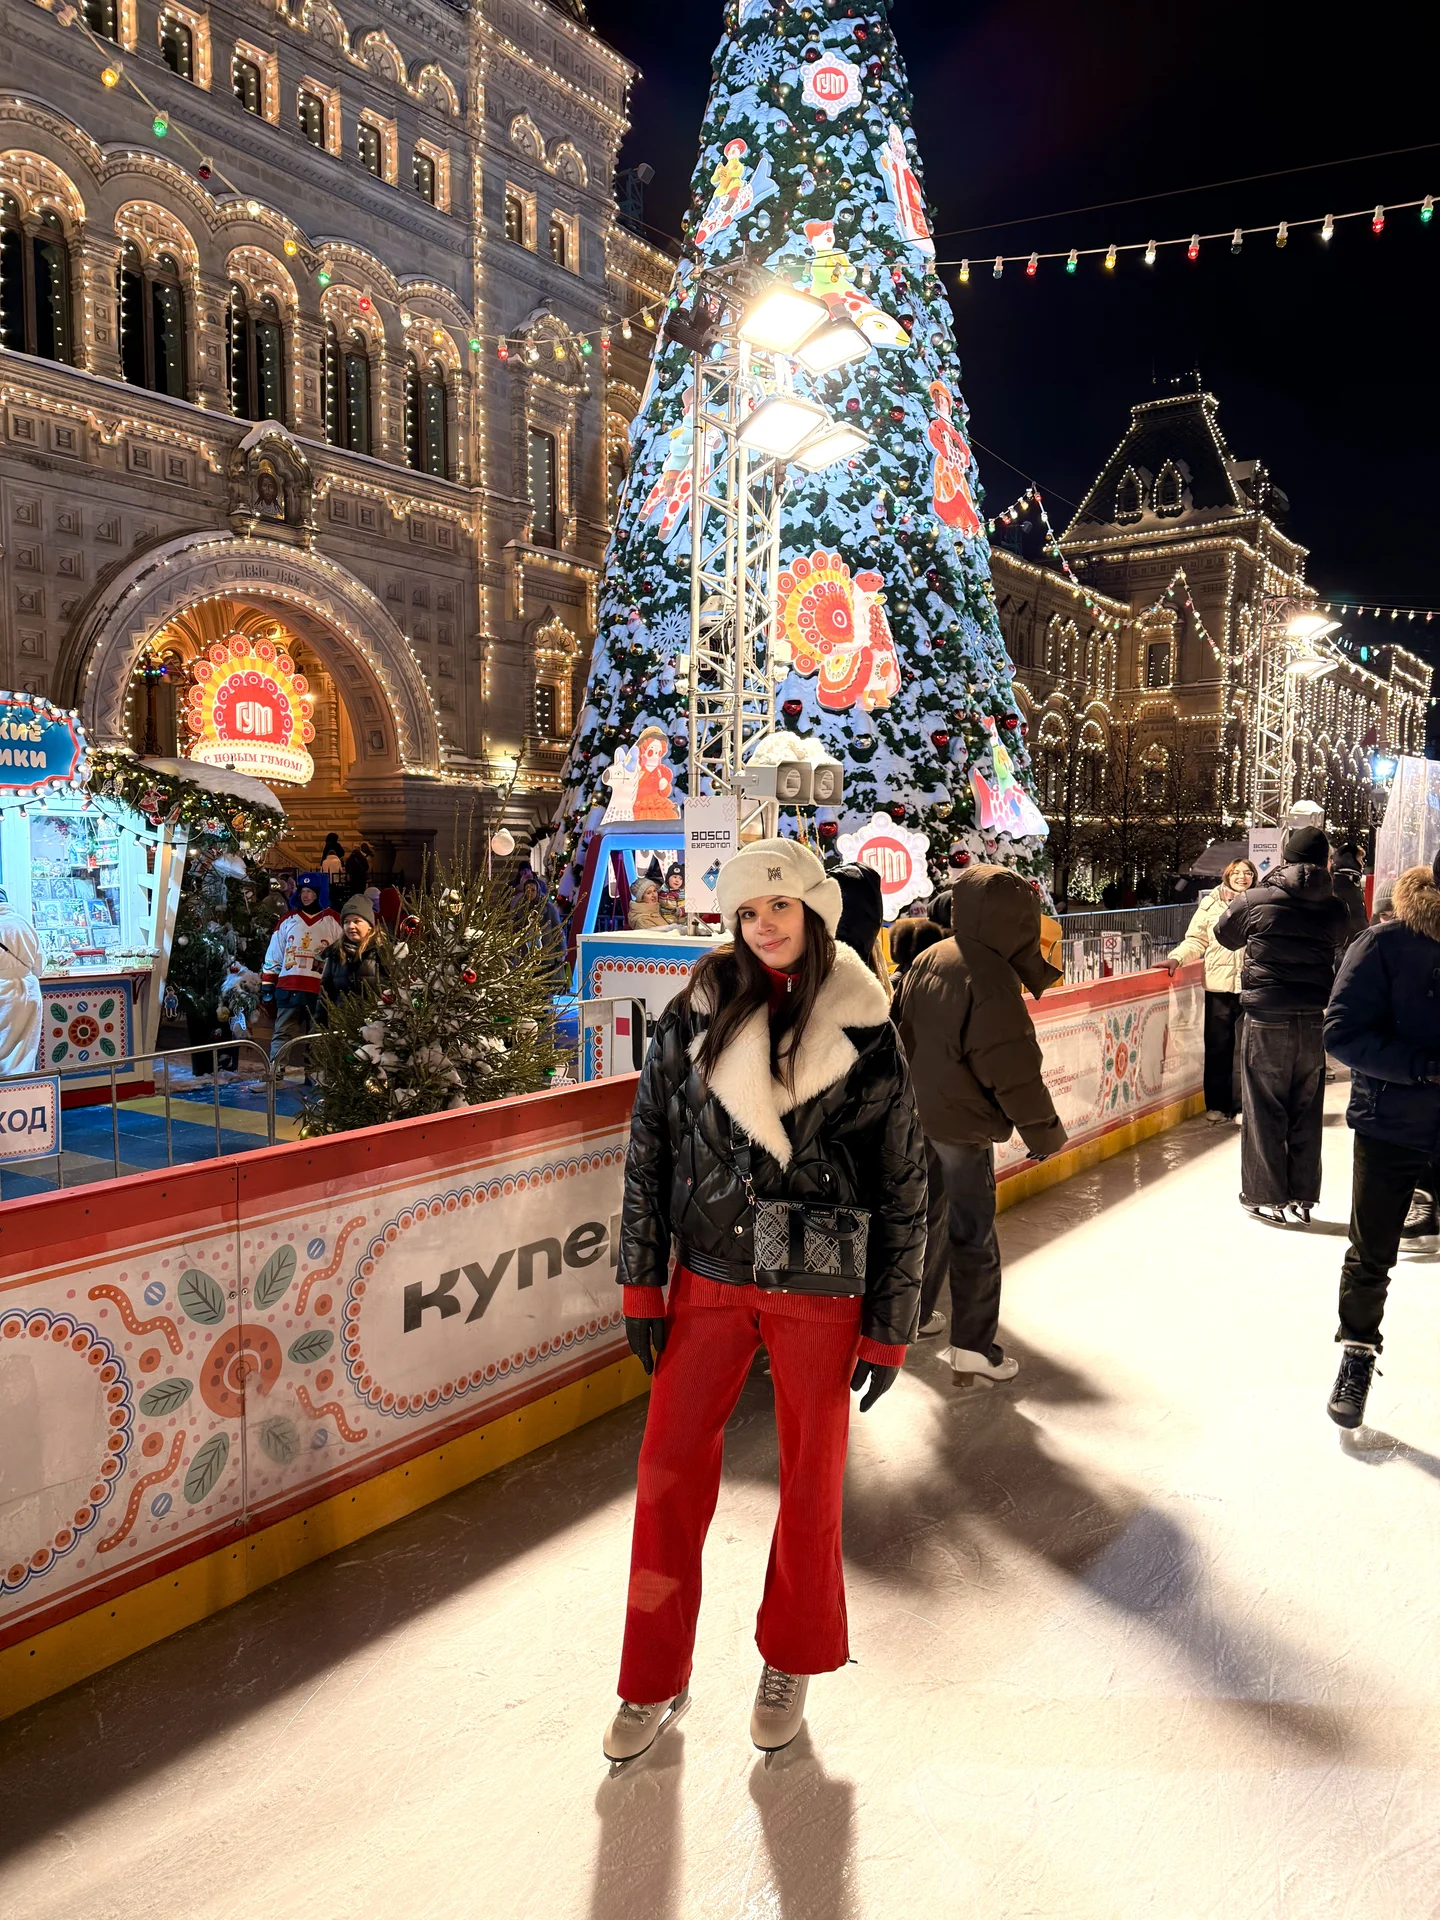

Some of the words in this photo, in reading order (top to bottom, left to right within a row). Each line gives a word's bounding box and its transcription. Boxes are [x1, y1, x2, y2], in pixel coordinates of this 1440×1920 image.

[816, 73, 846, 94] ГУМ
[235, 701, 273, 736] ГУМ
[214, 752, 258, 764] НОВЫМ
[261, 753, 303, 773] ГУМОМ!
[691, 831, 731, 841] BOSCO
